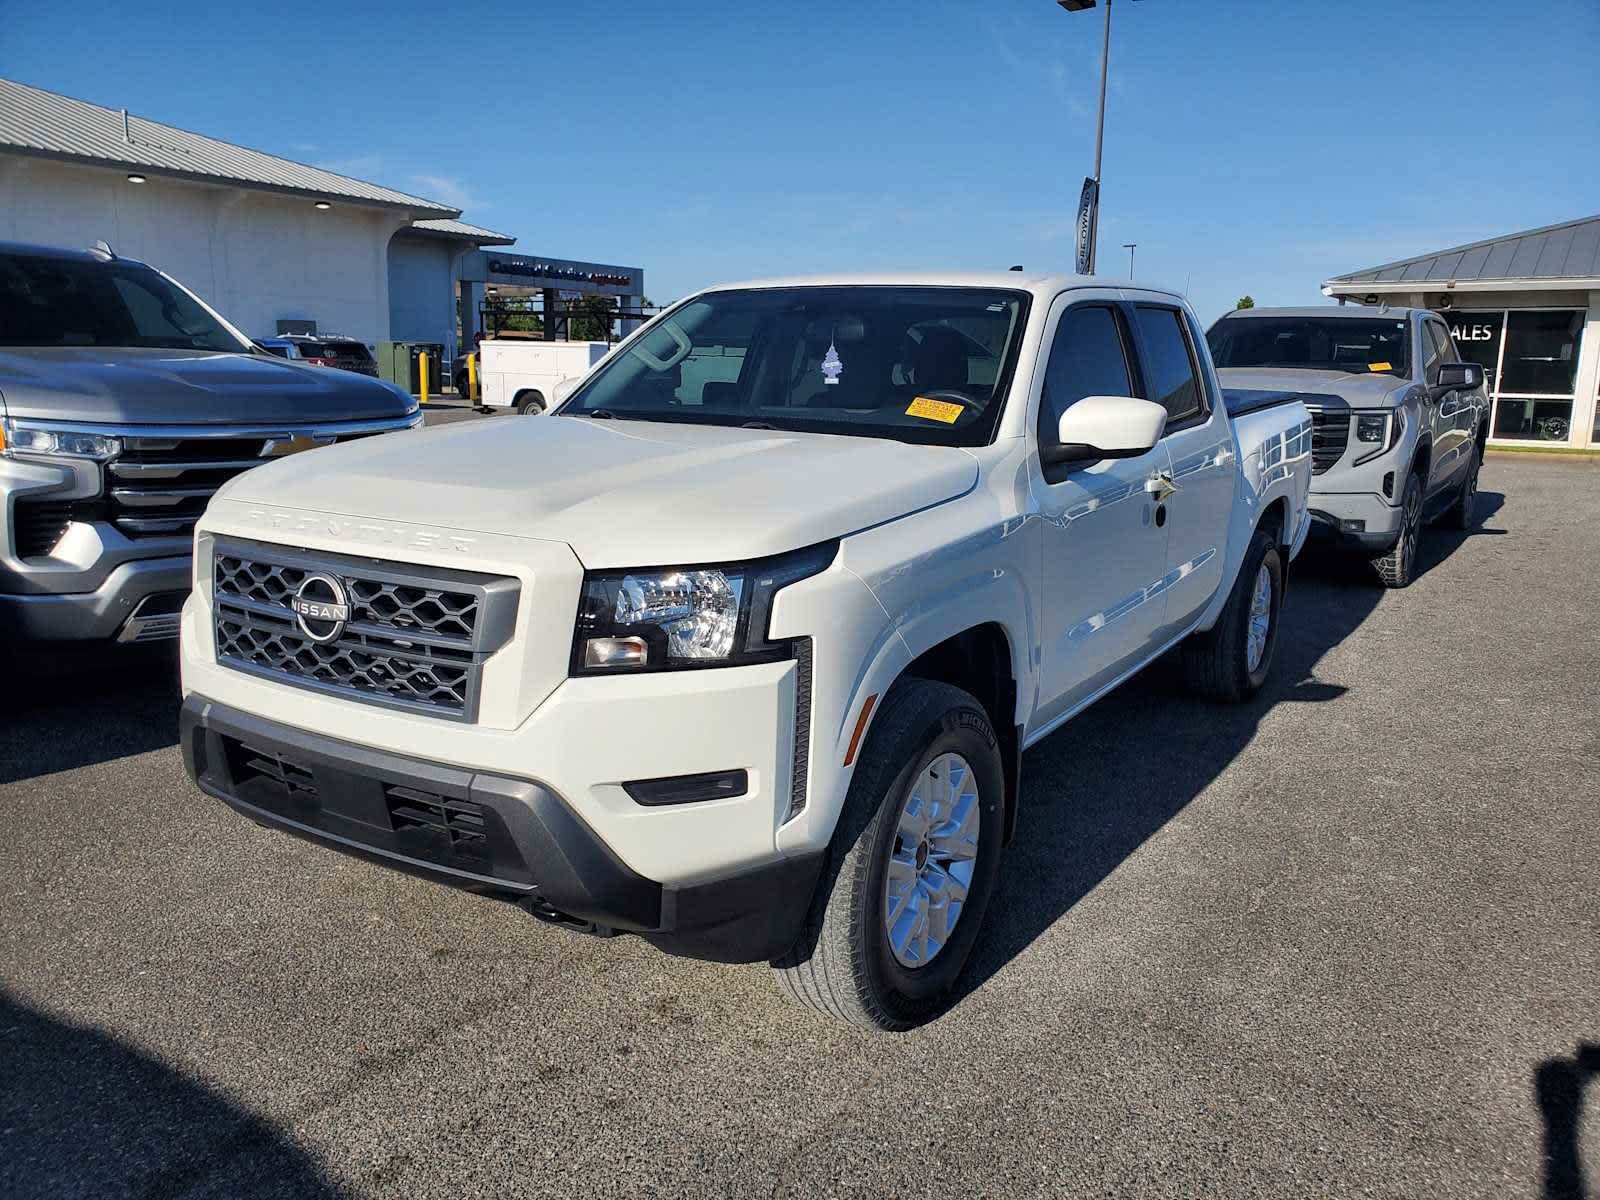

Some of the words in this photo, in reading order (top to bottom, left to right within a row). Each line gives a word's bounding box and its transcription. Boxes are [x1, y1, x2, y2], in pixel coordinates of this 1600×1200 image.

[1450, 324, 1492, 341] ALES
[248, 508, 478, 554] FRONTIER
[291, 599, 346, 620] NISSAN
